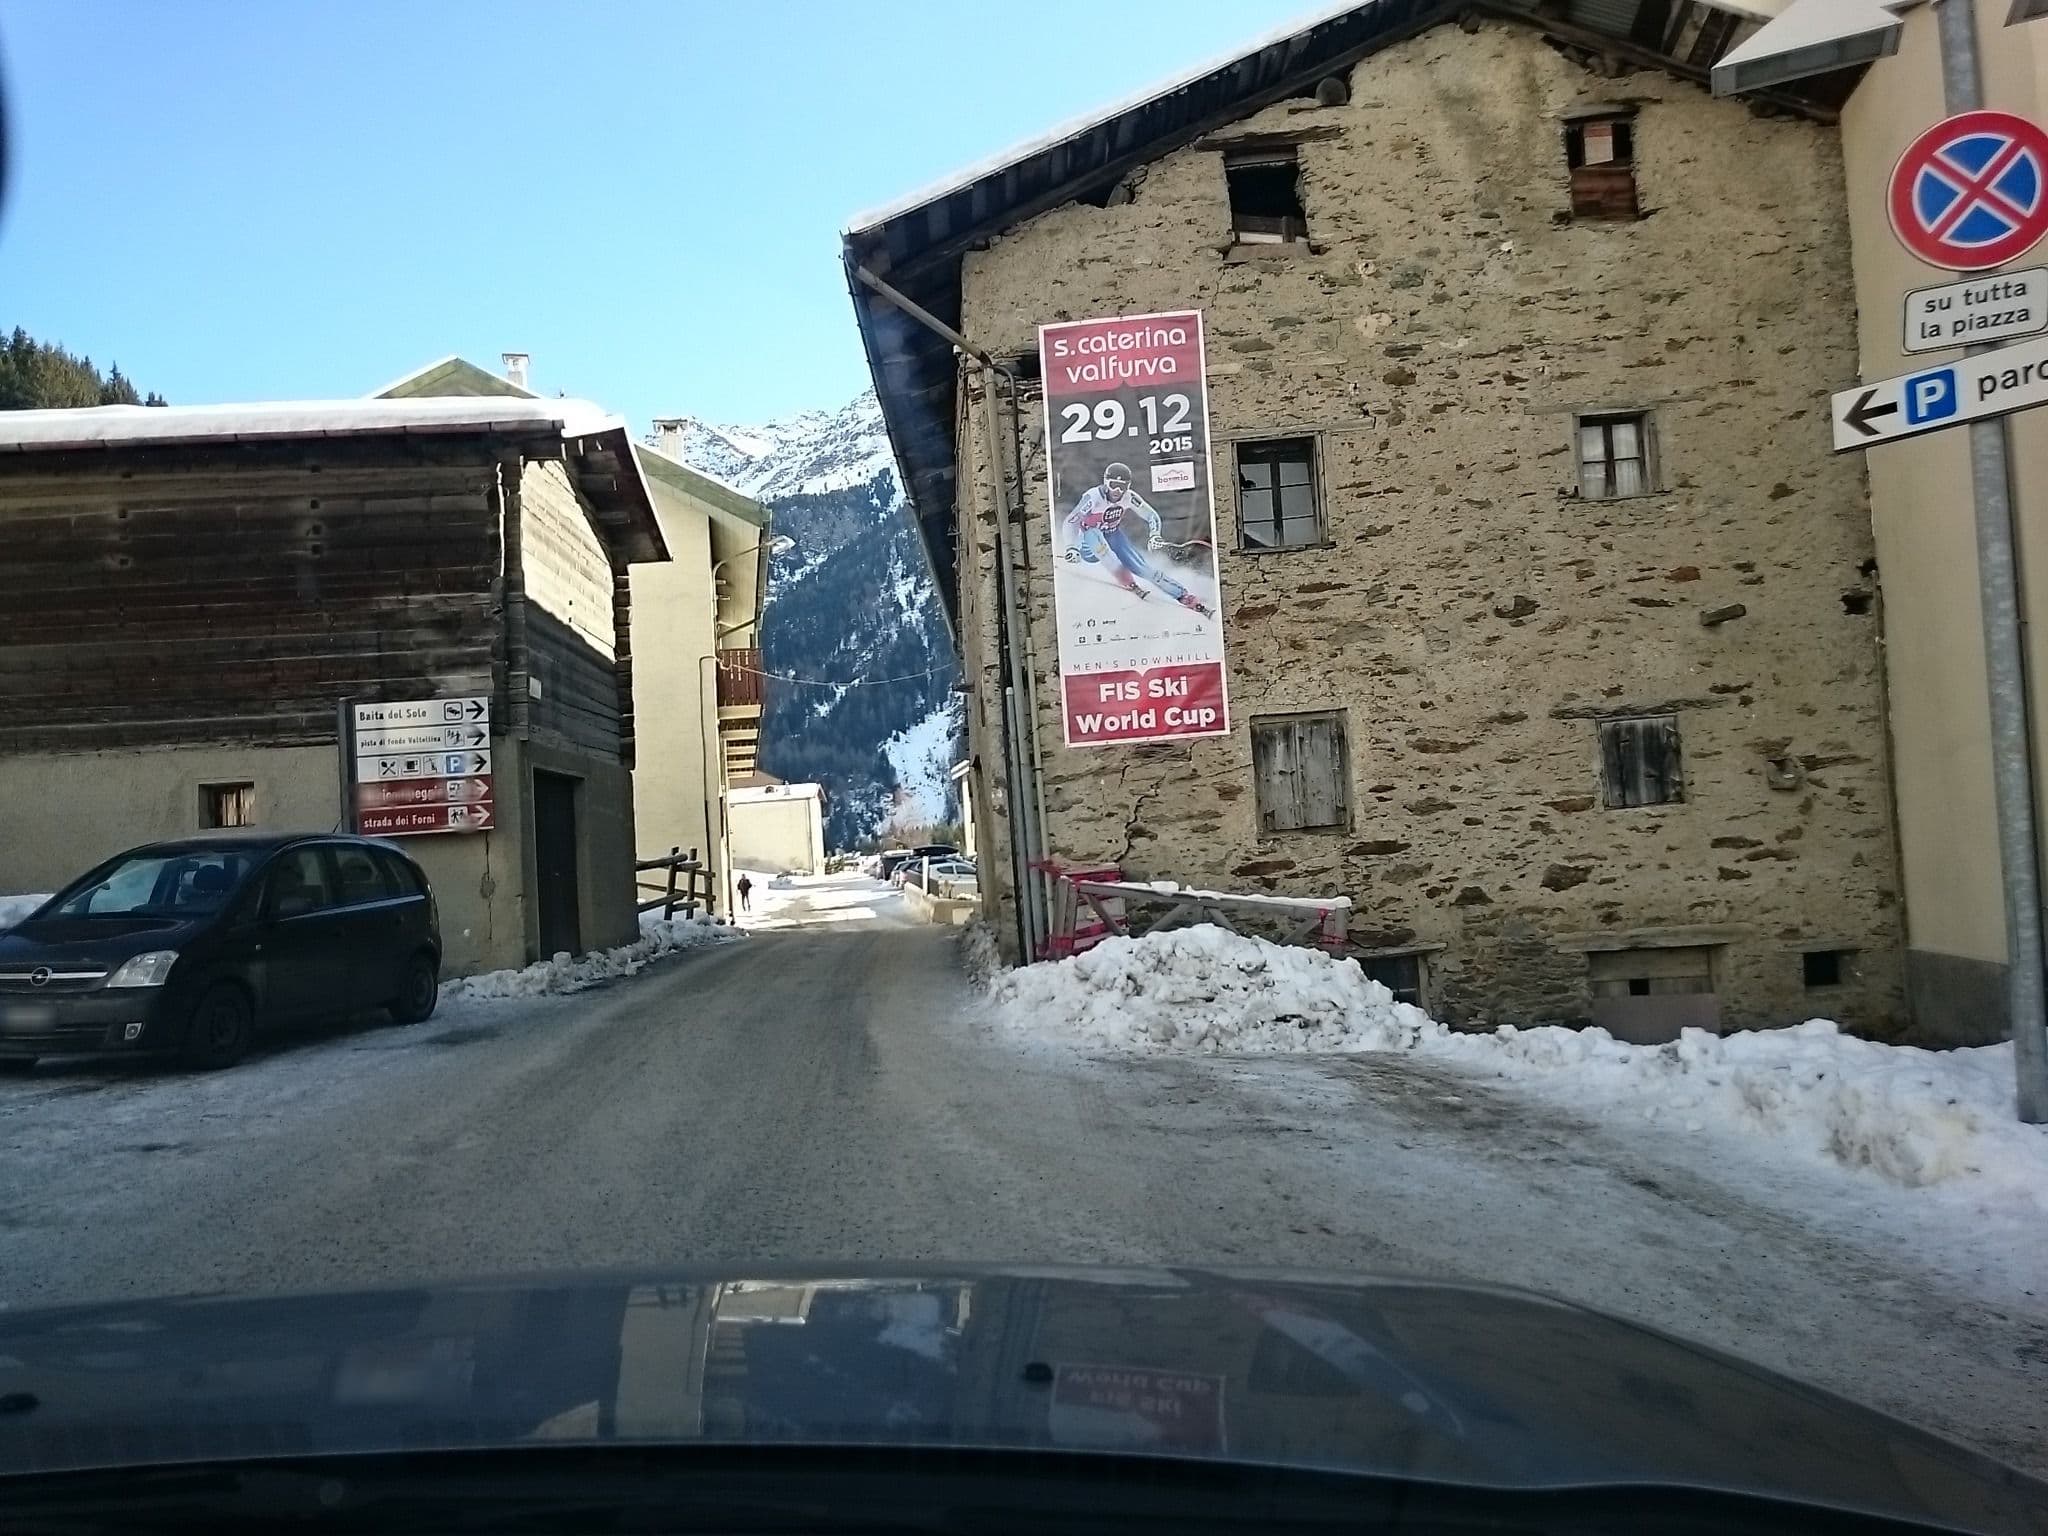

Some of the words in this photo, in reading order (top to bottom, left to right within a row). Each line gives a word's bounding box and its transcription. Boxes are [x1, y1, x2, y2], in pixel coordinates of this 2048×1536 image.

[1924, 297, 1952, 313] su
[1963, 281, 2028, 306] tutta
[1920, 322, 1942, 339] la
[1952, 308, 2030, 337] piazza
[1066, 355, 1177, 384] valfurva
[1060, 393, 1192, 444] 29.12
[1150, 436, 1193, 454] 2015
[1073, 660, 1119, 672] MEN'S
[1130, 652, 1211, 667] DOWNHILL
[1099, 681, 1141, 703] FIS
[1148, 676, 1188, 698] Ski
[359, 711, 384, 721] Baita
[388, 709, 403, 719] del
[406, 708, 427, 718] Sole
[1075, 708, 1157, 734] World
[1164, 706, 1216, 728] Cup
[364, 815, 393, 828] strada
[395, 813, 409, 823] dei
[412, 813, 435, 825] Forni
